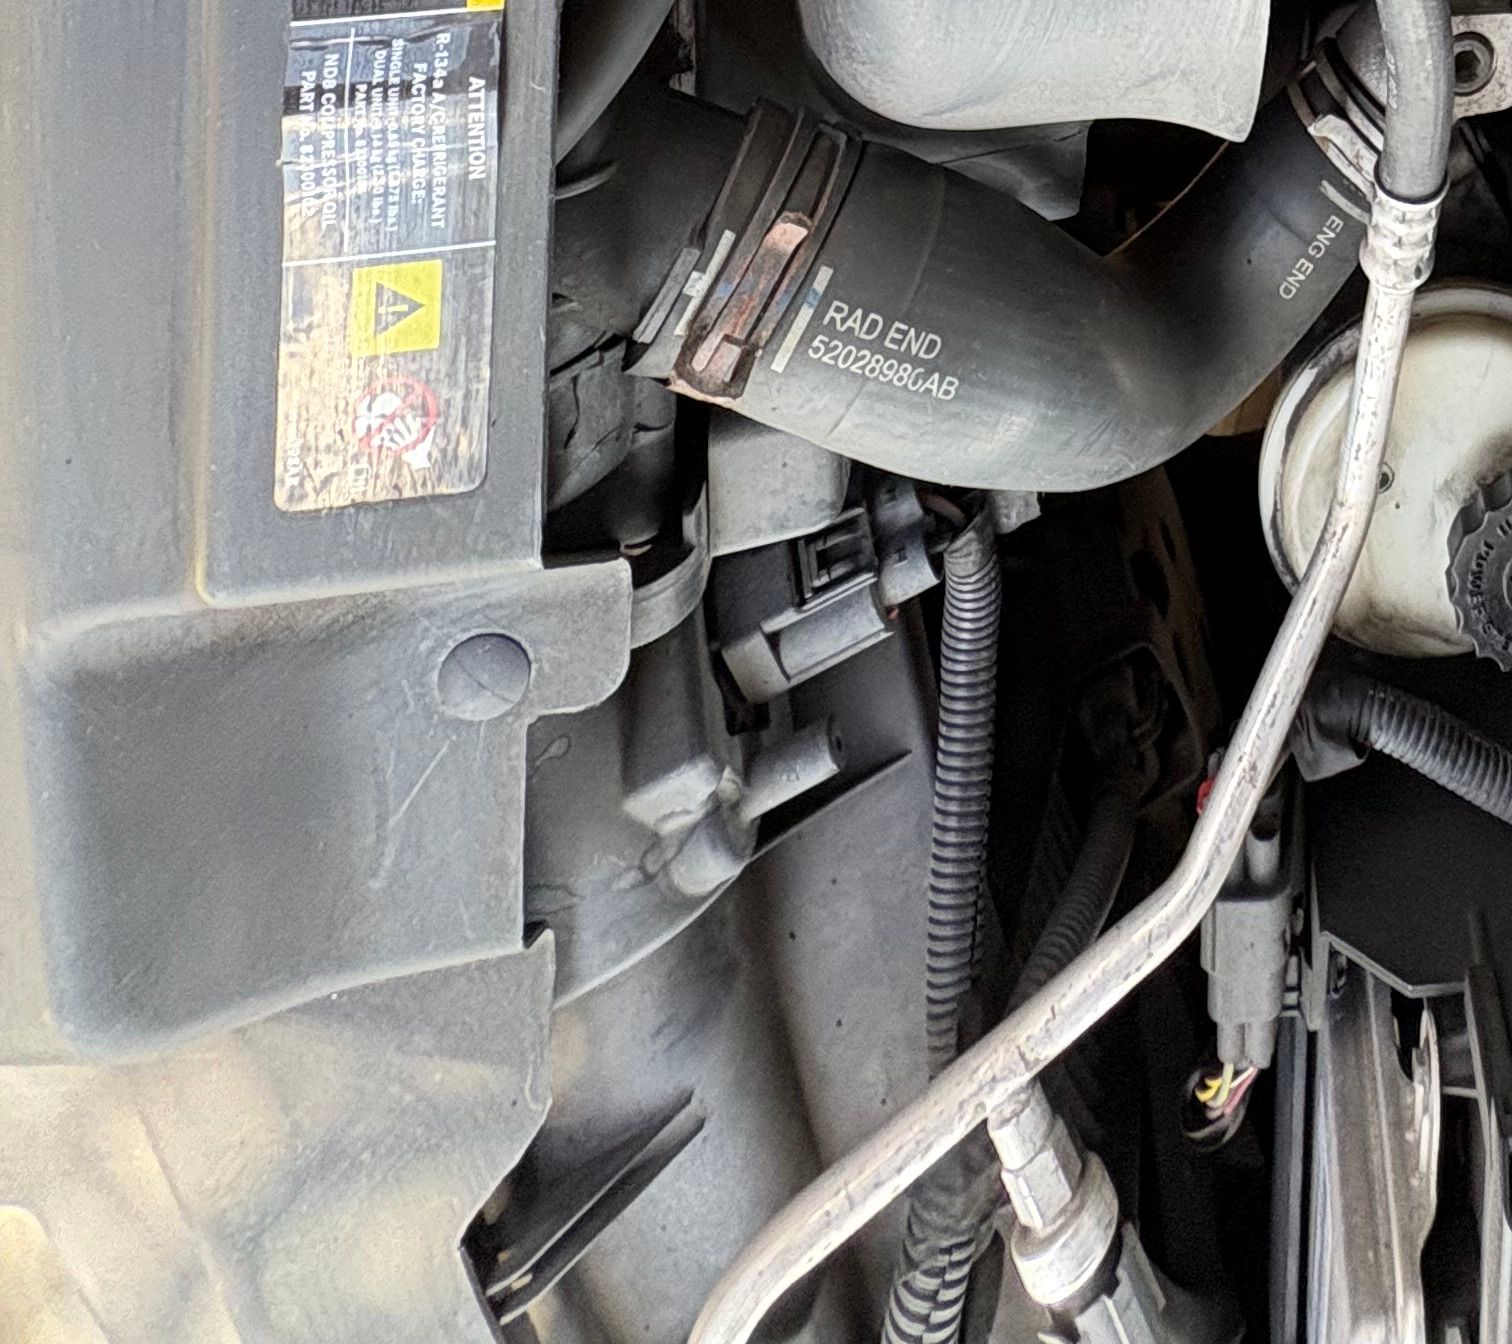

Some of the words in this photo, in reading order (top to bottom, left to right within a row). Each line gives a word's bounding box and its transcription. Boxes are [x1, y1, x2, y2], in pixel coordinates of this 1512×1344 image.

[371, 50, 386, 85] DUAL
[388, 38, 404, 85] SINGLE
[432, 31, 451, 89] R-134a
[299, 70, 317, 112] PART
[355, 83, 367, 115] PART
[410, 62, 428, 134] FACTORY
[468, 76, 486, 180] ATTENTION
[411, 137, 427, 204] CHARGE:
[321, 201, 337, 228] OIL
[1307, 214, 1344, 259] ENG
[1279, 258, 1315, 300] END
[822, 299, 884, 341] RAD
[883, 320, 943, 361] END
